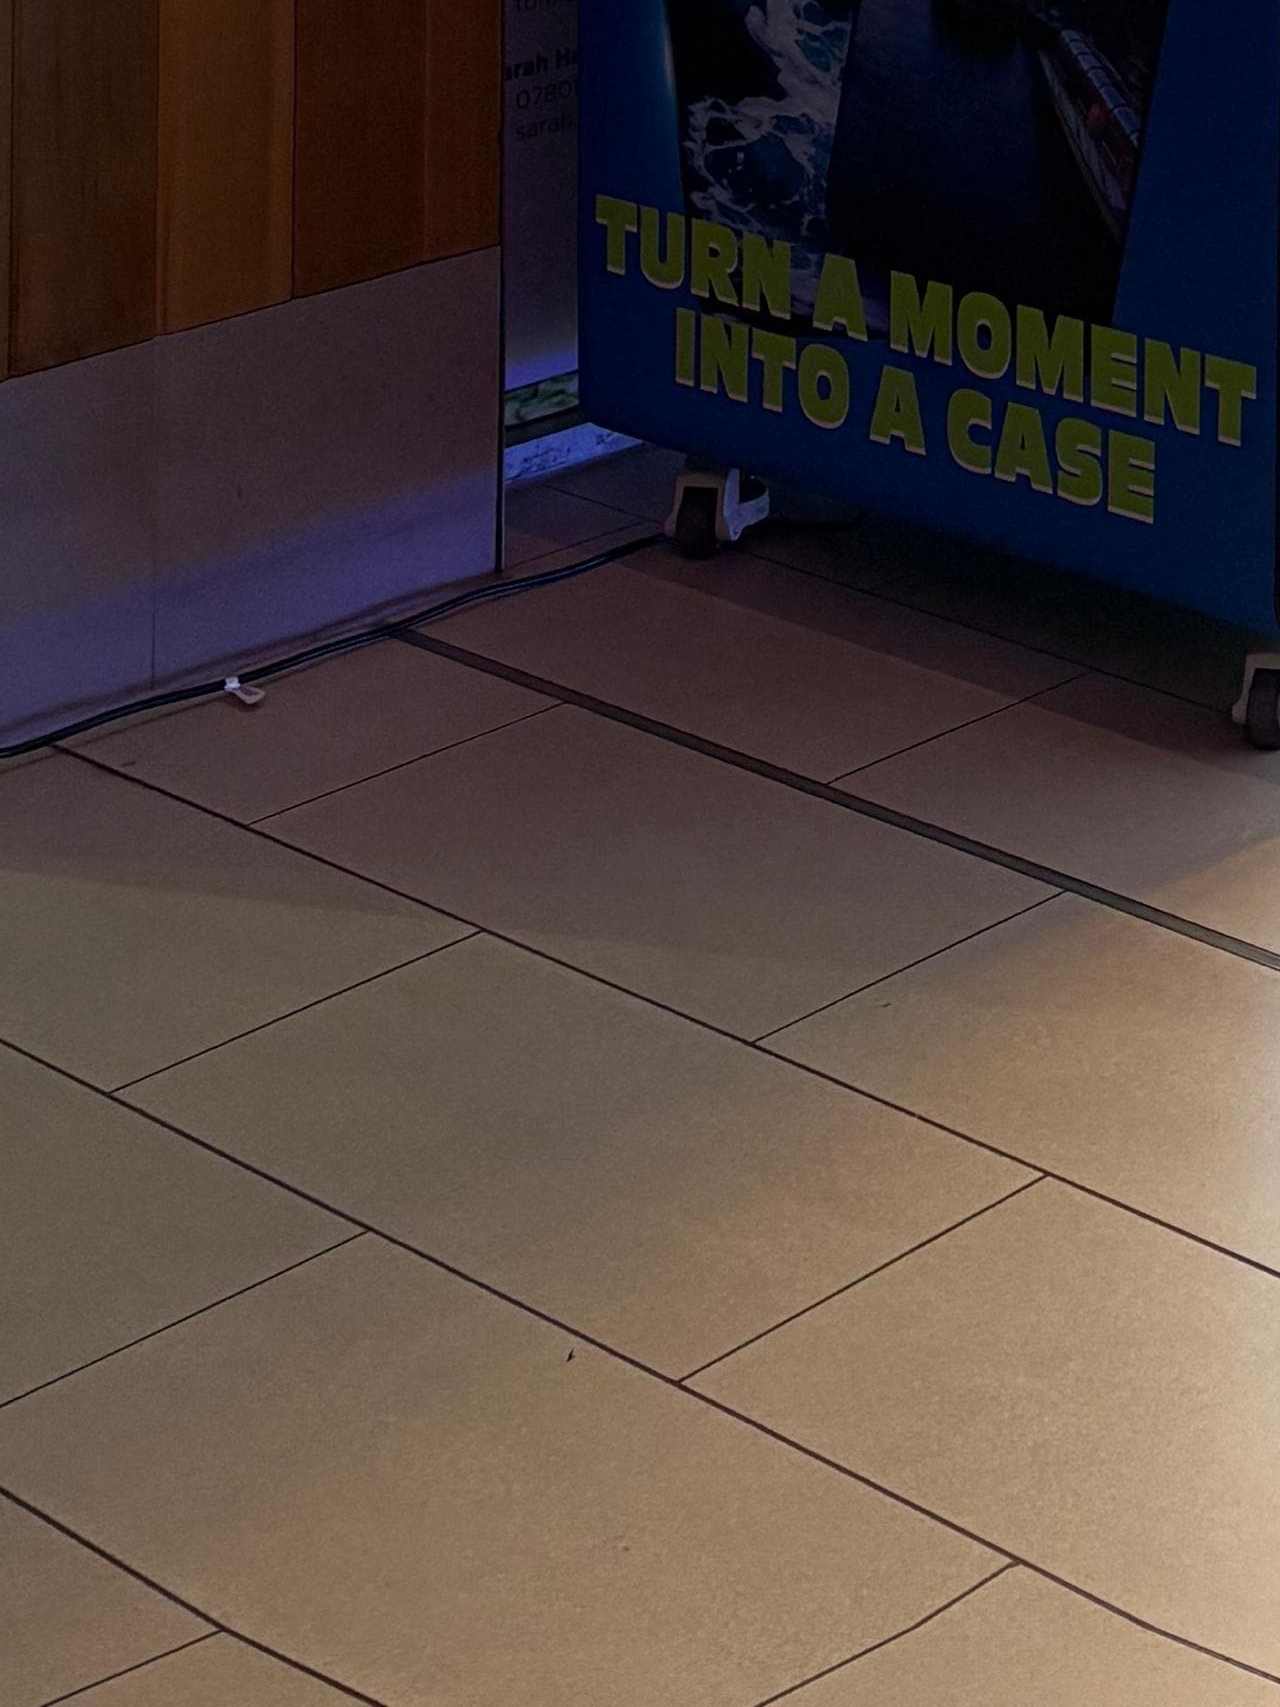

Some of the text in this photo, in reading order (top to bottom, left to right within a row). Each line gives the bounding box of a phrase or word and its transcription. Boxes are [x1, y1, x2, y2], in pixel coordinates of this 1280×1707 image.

[594, 194, 1258, 448] TURN A MOMENT
[674, 307, 1156, 525] INTO A CASE
